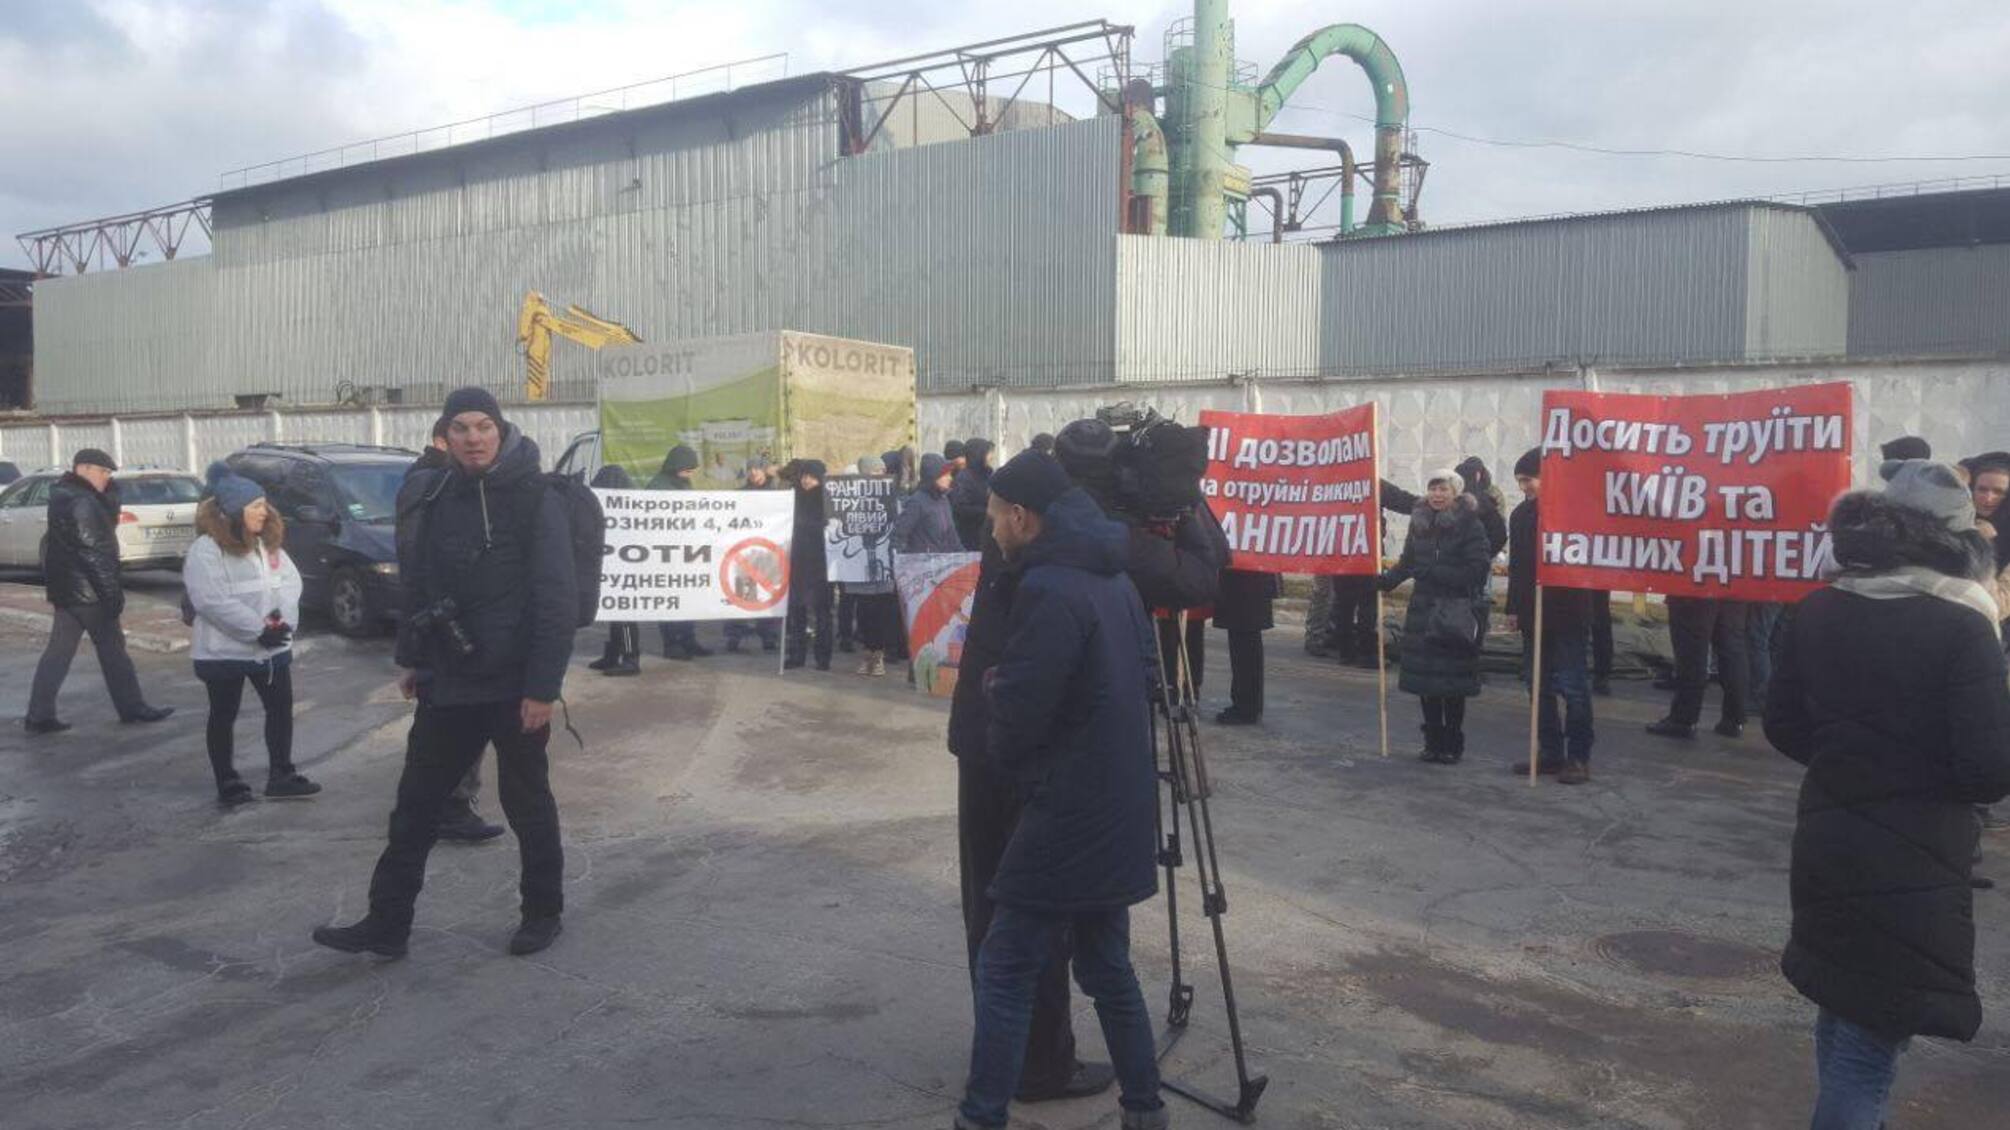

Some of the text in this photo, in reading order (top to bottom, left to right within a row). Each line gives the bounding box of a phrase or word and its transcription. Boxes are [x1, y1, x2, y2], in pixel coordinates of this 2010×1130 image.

[603, 351, 696, 378] KOLORIT
[797, 341, 901, 377] KOLORIT
[1542, 406, 1843, 464] Досить труїти
[1234, 431, 1371, 470] дозволам
[825, 478, 894, 497] ФАНПЛІТ
[1223, 478, 1309, 507] отруйні
[1311, 479, 1371, 504] викиди
[1605, 466, 1774, 520] КИЇВ та
[605, 495, 736, 513] Мікрорайон
[603, 516, 696, 531] ОЗНЯКИ
[1220, 511, 1370, 556] АНПЛИТА
[600, 544, 712, 563] РОТИ
[1542, 522, 1836, 585] наших ДІТЕЙ
[599, 574, 711, 591] РУДНЕННЯ
[601, 596, 680, 610] ОВІТРЯ
